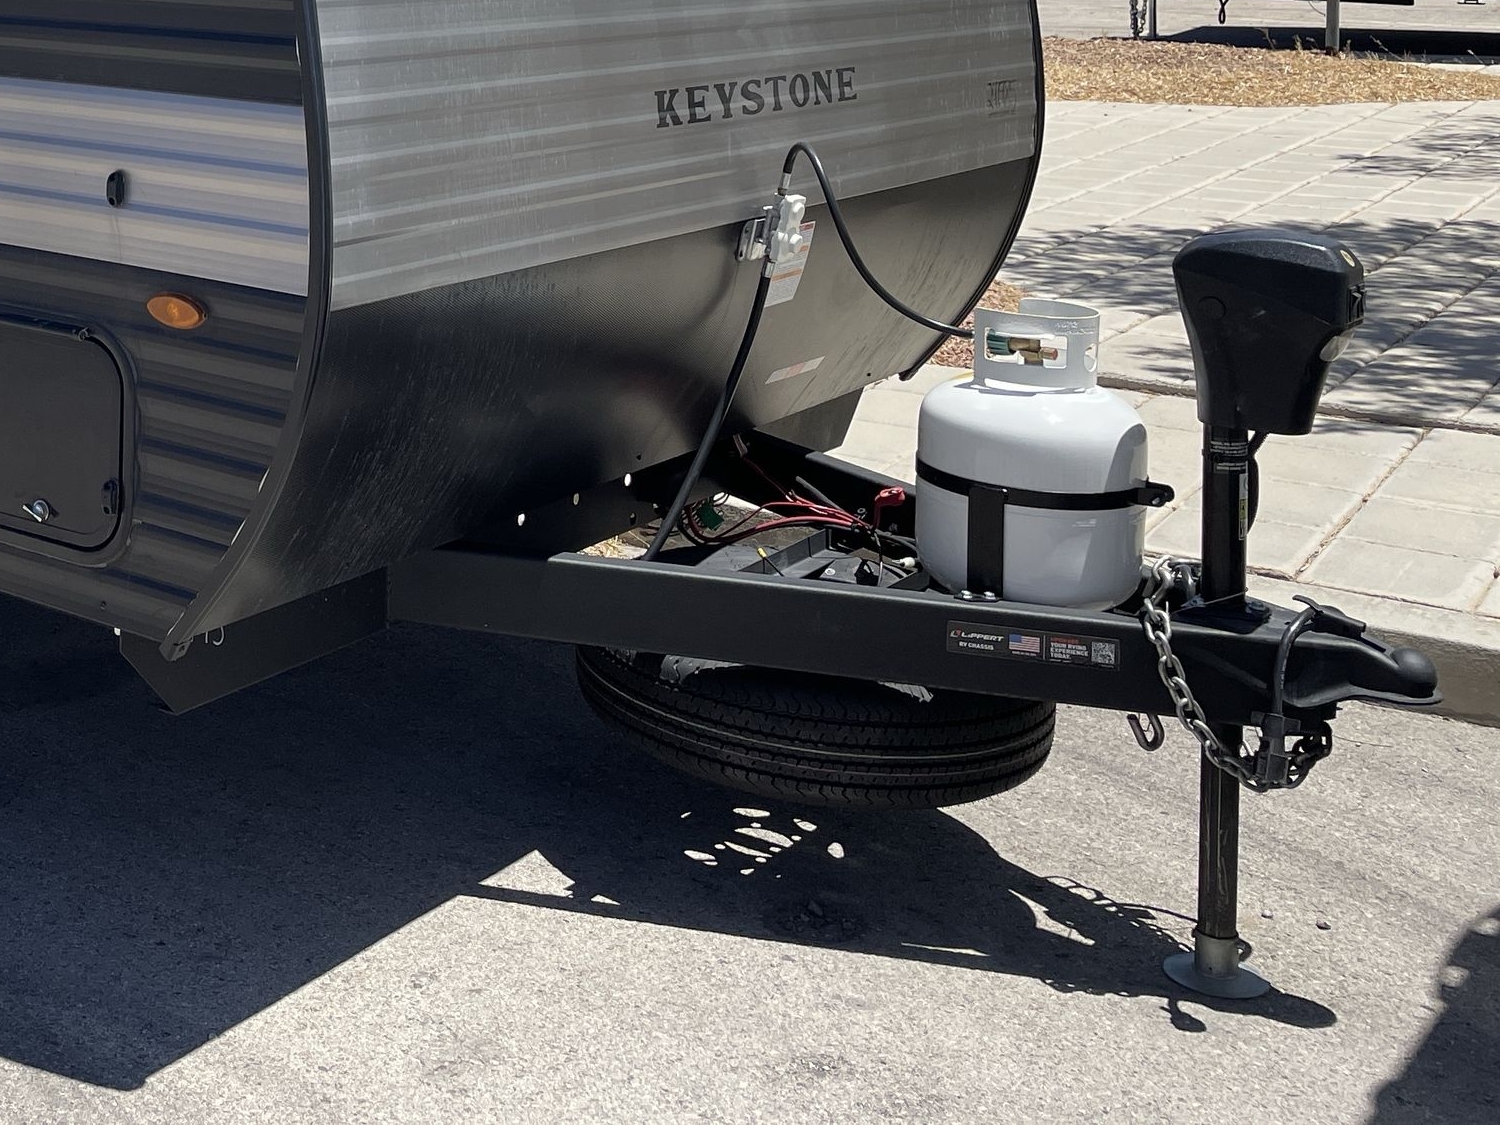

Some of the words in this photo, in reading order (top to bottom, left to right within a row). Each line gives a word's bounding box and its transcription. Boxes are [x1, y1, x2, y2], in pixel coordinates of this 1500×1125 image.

[654, 67, 858, 128] KEYSTONE
[968, 642, 994, 651] CHASSIS
[1051, 647, 1089, 657] EXPERIENCE
